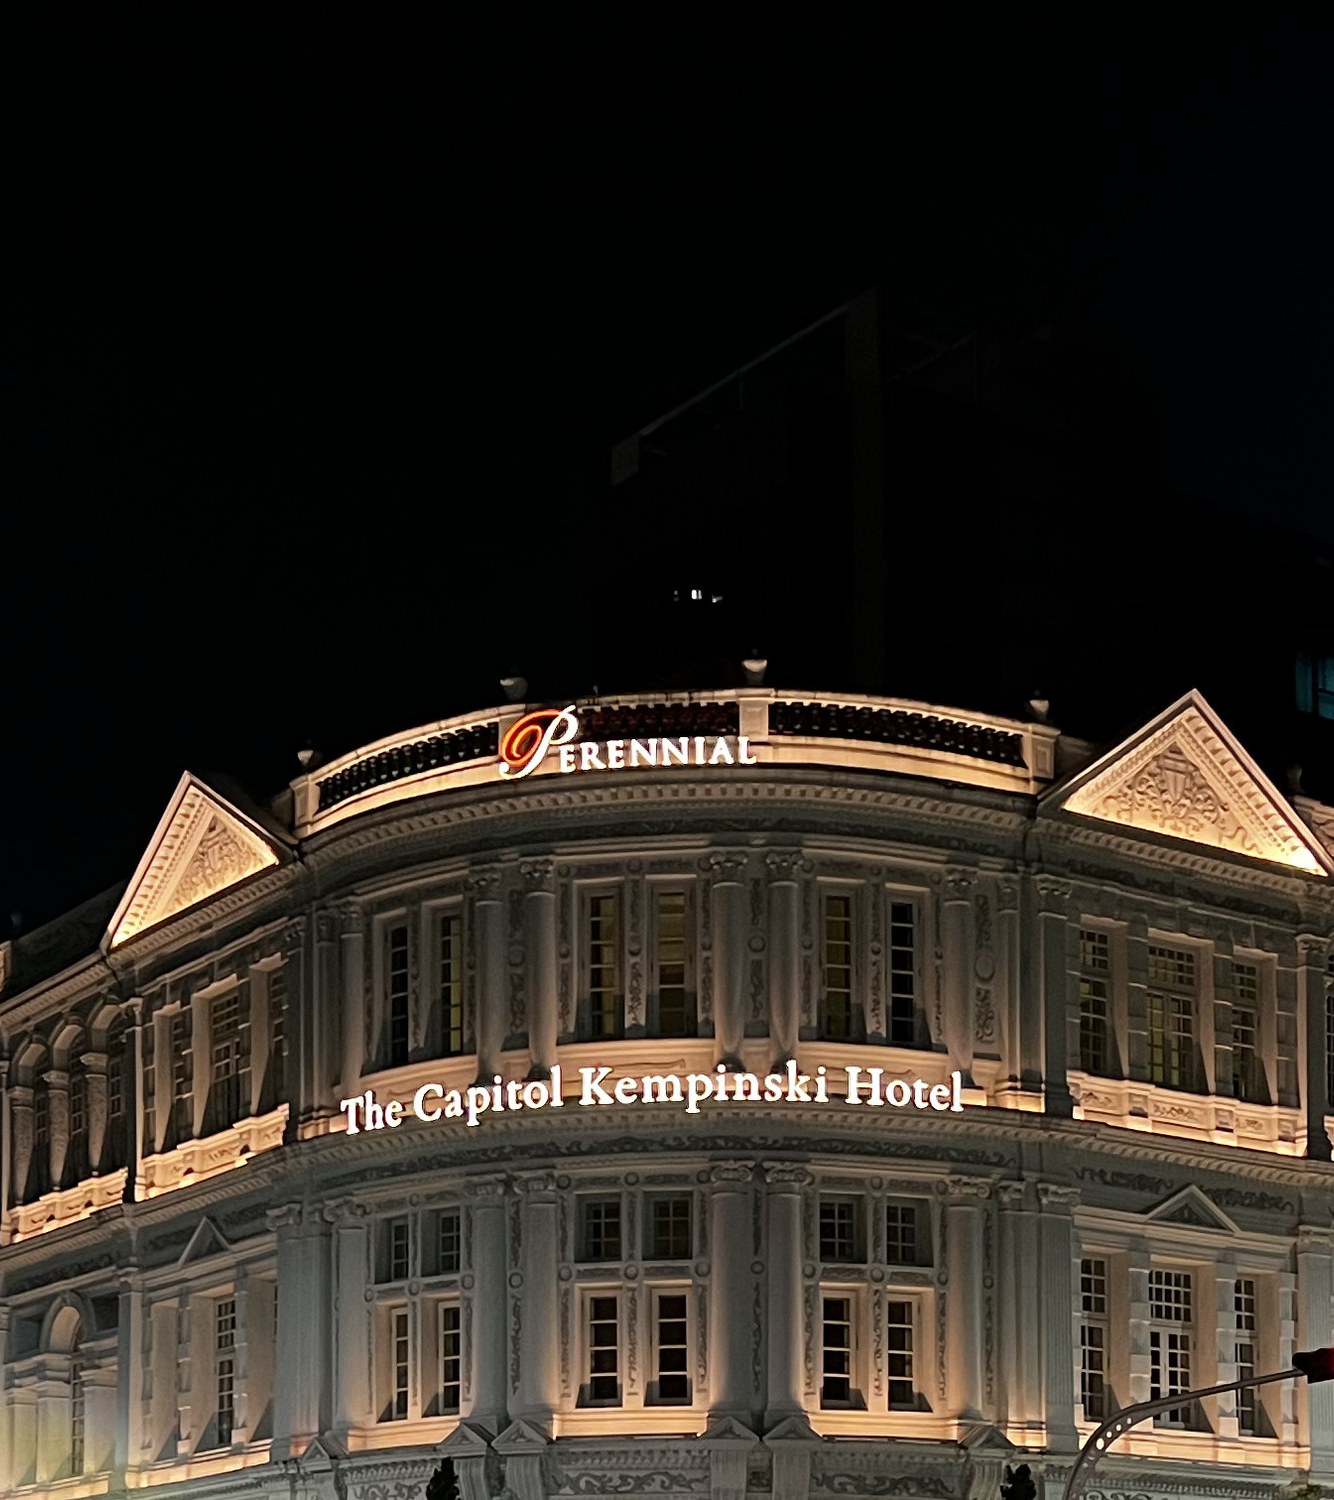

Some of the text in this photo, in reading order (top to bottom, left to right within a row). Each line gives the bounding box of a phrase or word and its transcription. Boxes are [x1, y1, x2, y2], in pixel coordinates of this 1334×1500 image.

[499, 704, 757, 780] PERENNIAL
[340, 1059, 964, 1135] The Capitol Kempinski Hotel
